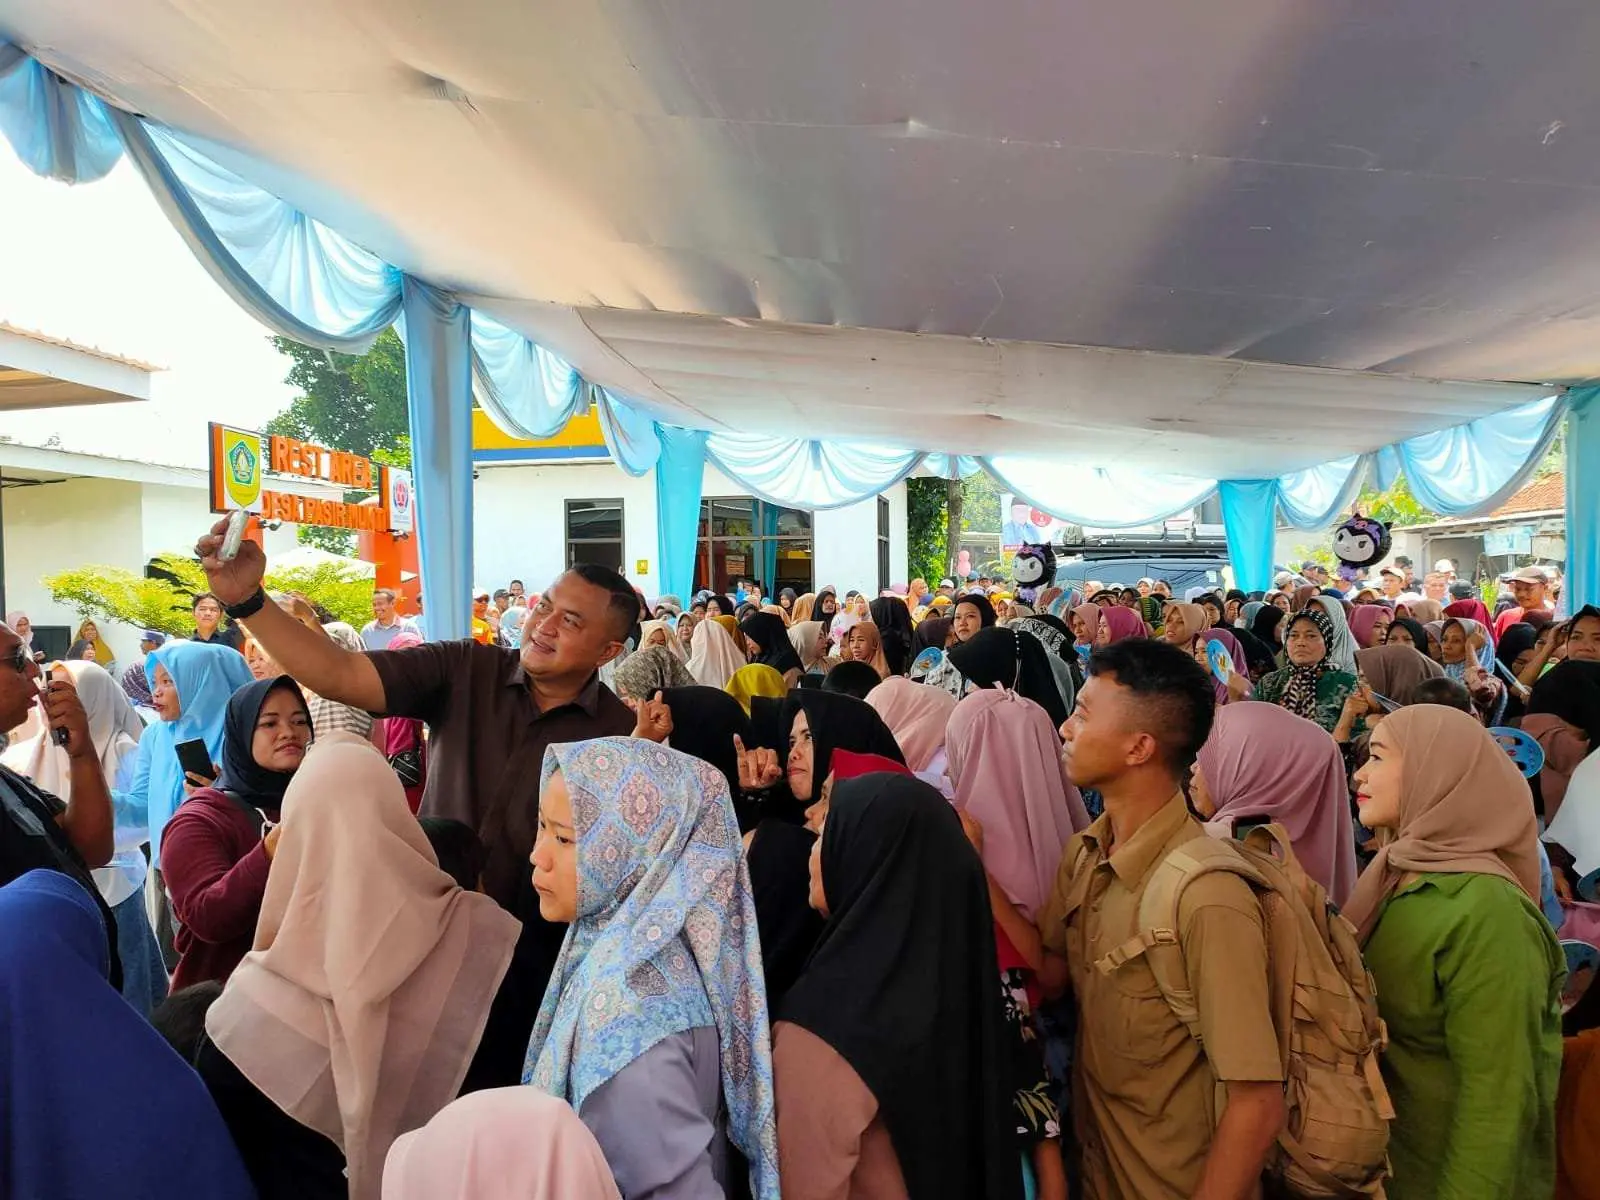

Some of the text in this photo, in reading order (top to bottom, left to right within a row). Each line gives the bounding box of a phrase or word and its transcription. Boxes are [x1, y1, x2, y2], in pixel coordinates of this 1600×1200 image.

[270, 434, 324, 479] REST
[330, 450, 373, 490] AREA
[261, 489, 302, 522] DESA
[302, 497, 347, 528] PASIR
